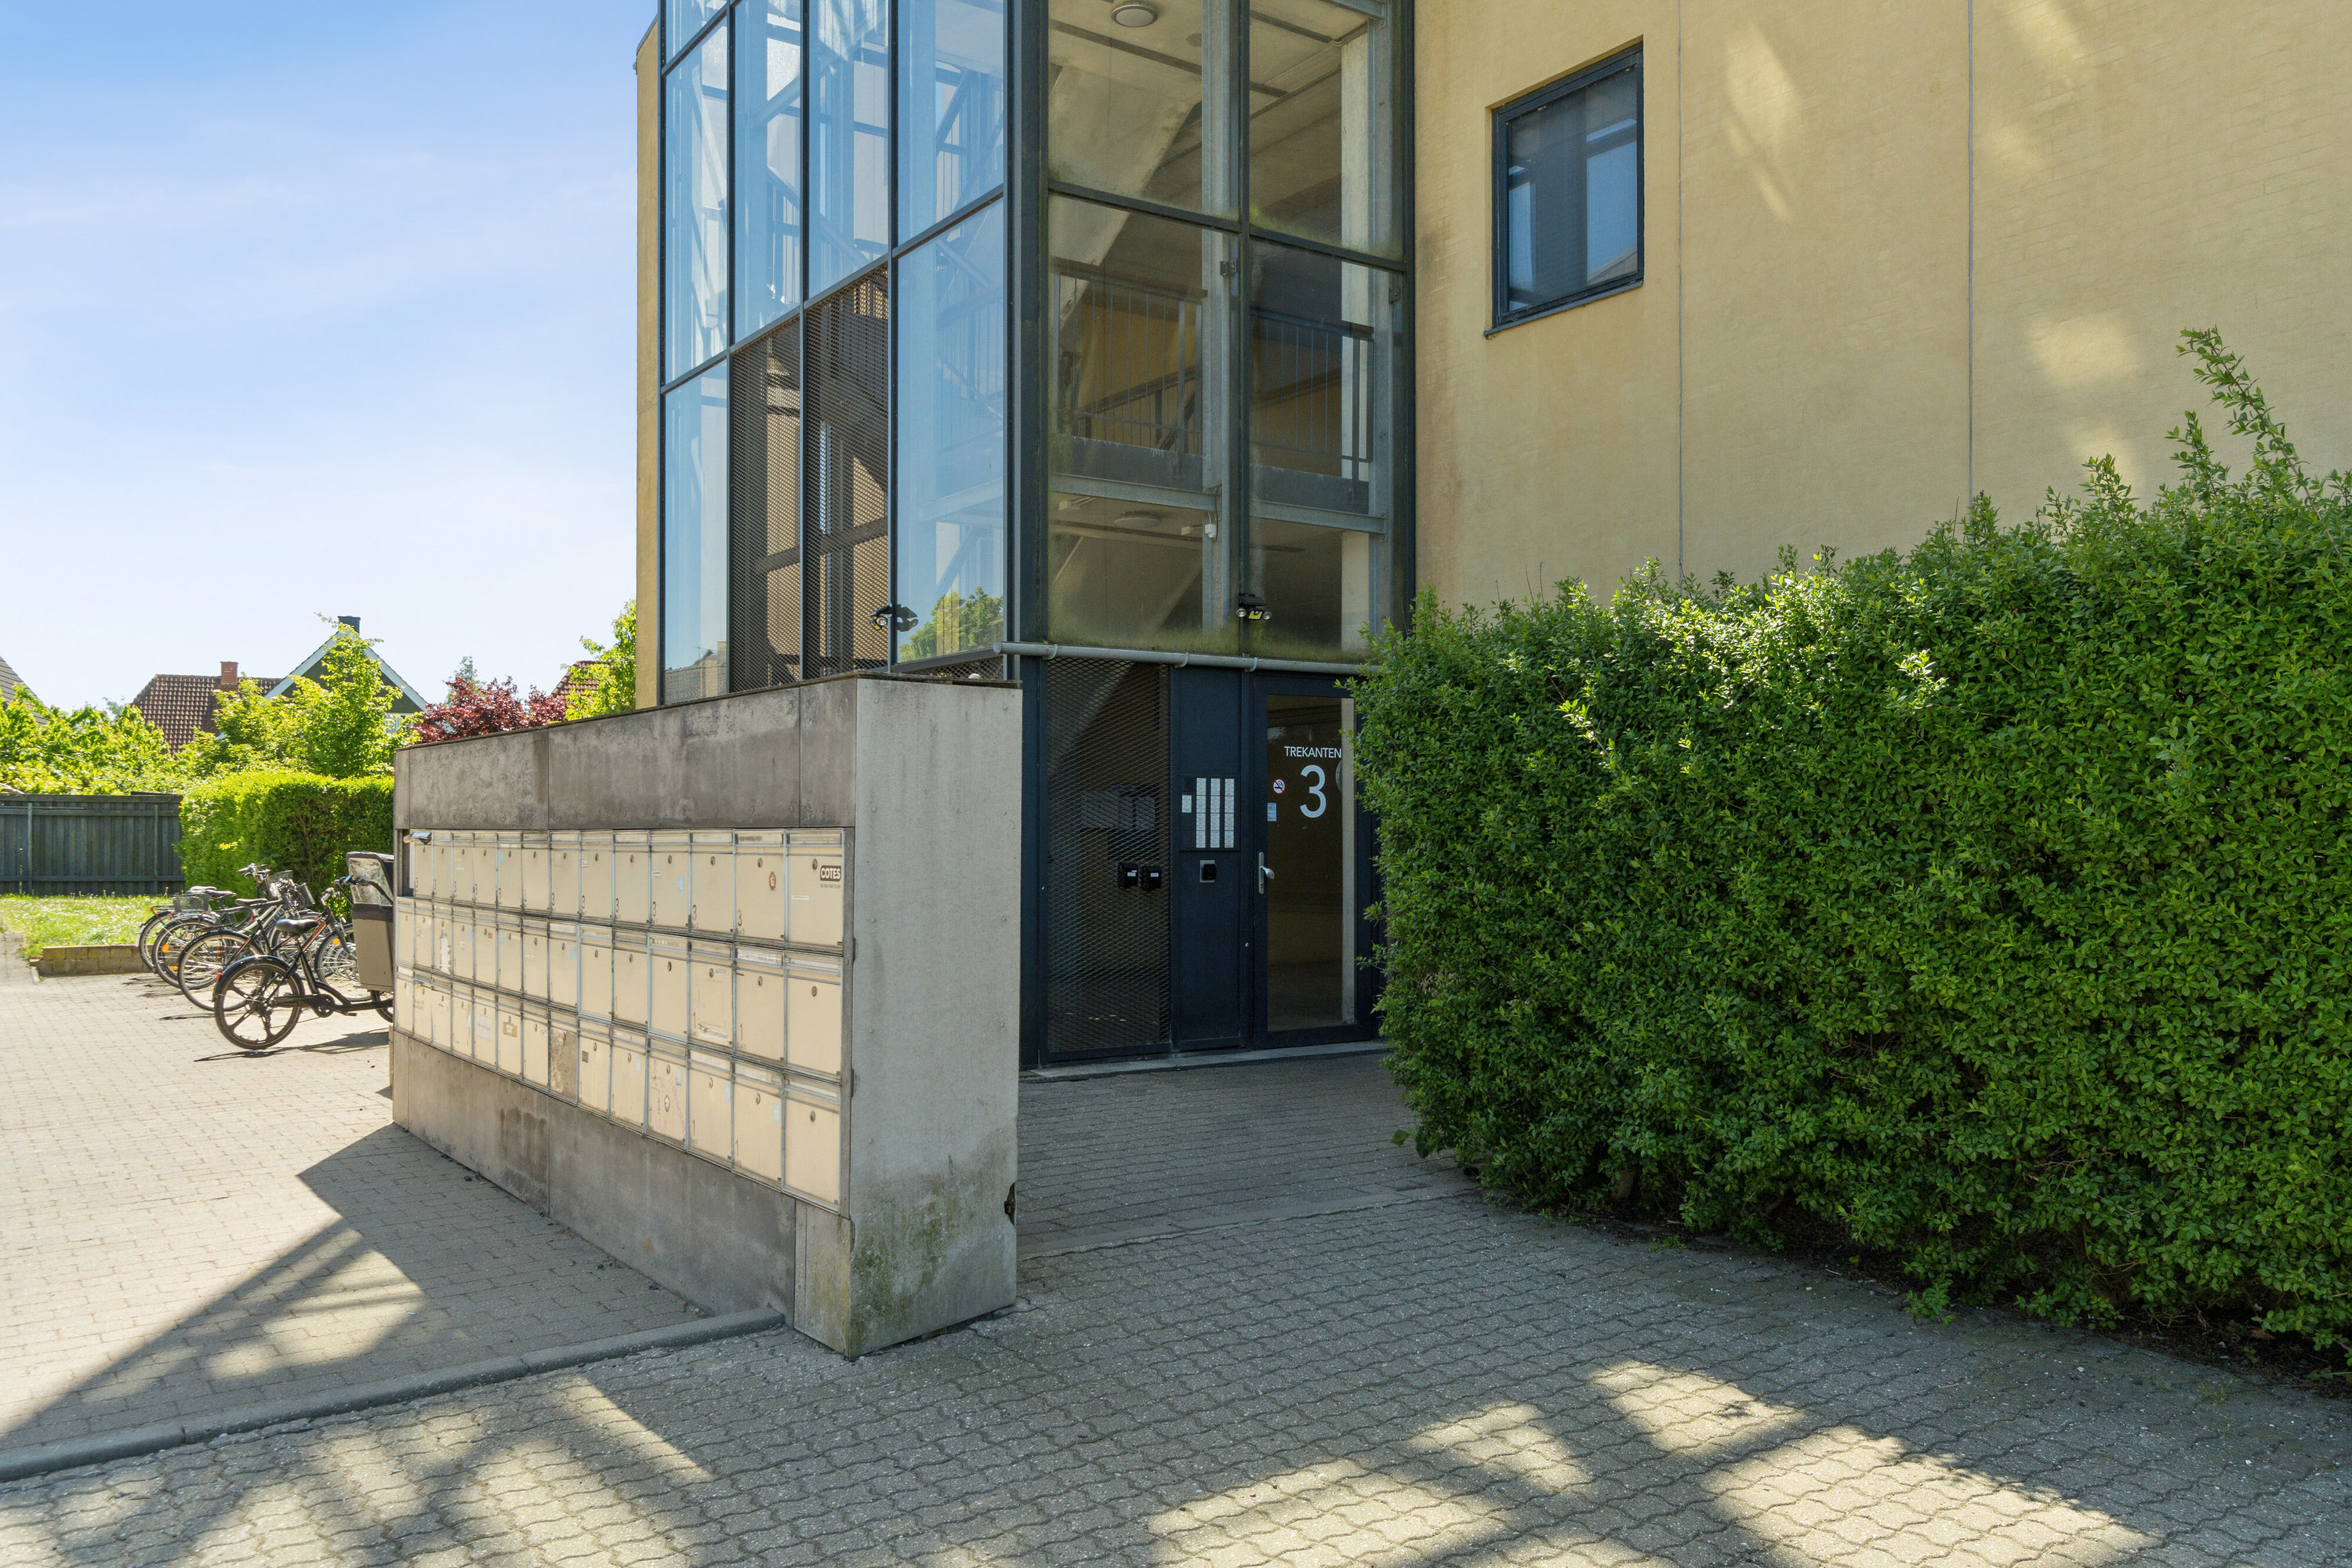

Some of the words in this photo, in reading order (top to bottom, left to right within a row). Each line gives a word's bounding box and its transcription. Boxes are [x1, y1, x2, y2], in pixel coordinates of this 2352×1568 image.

[1284, 746, 1341, 759] TREKANTEN
[1300, 764, 1327, 818] 3
[821, 867, 841, 879] COTES
[652, 902, 657, 916] 3
[692, 904, 697, 920] 3
[738, 909, 742, 927] 3
